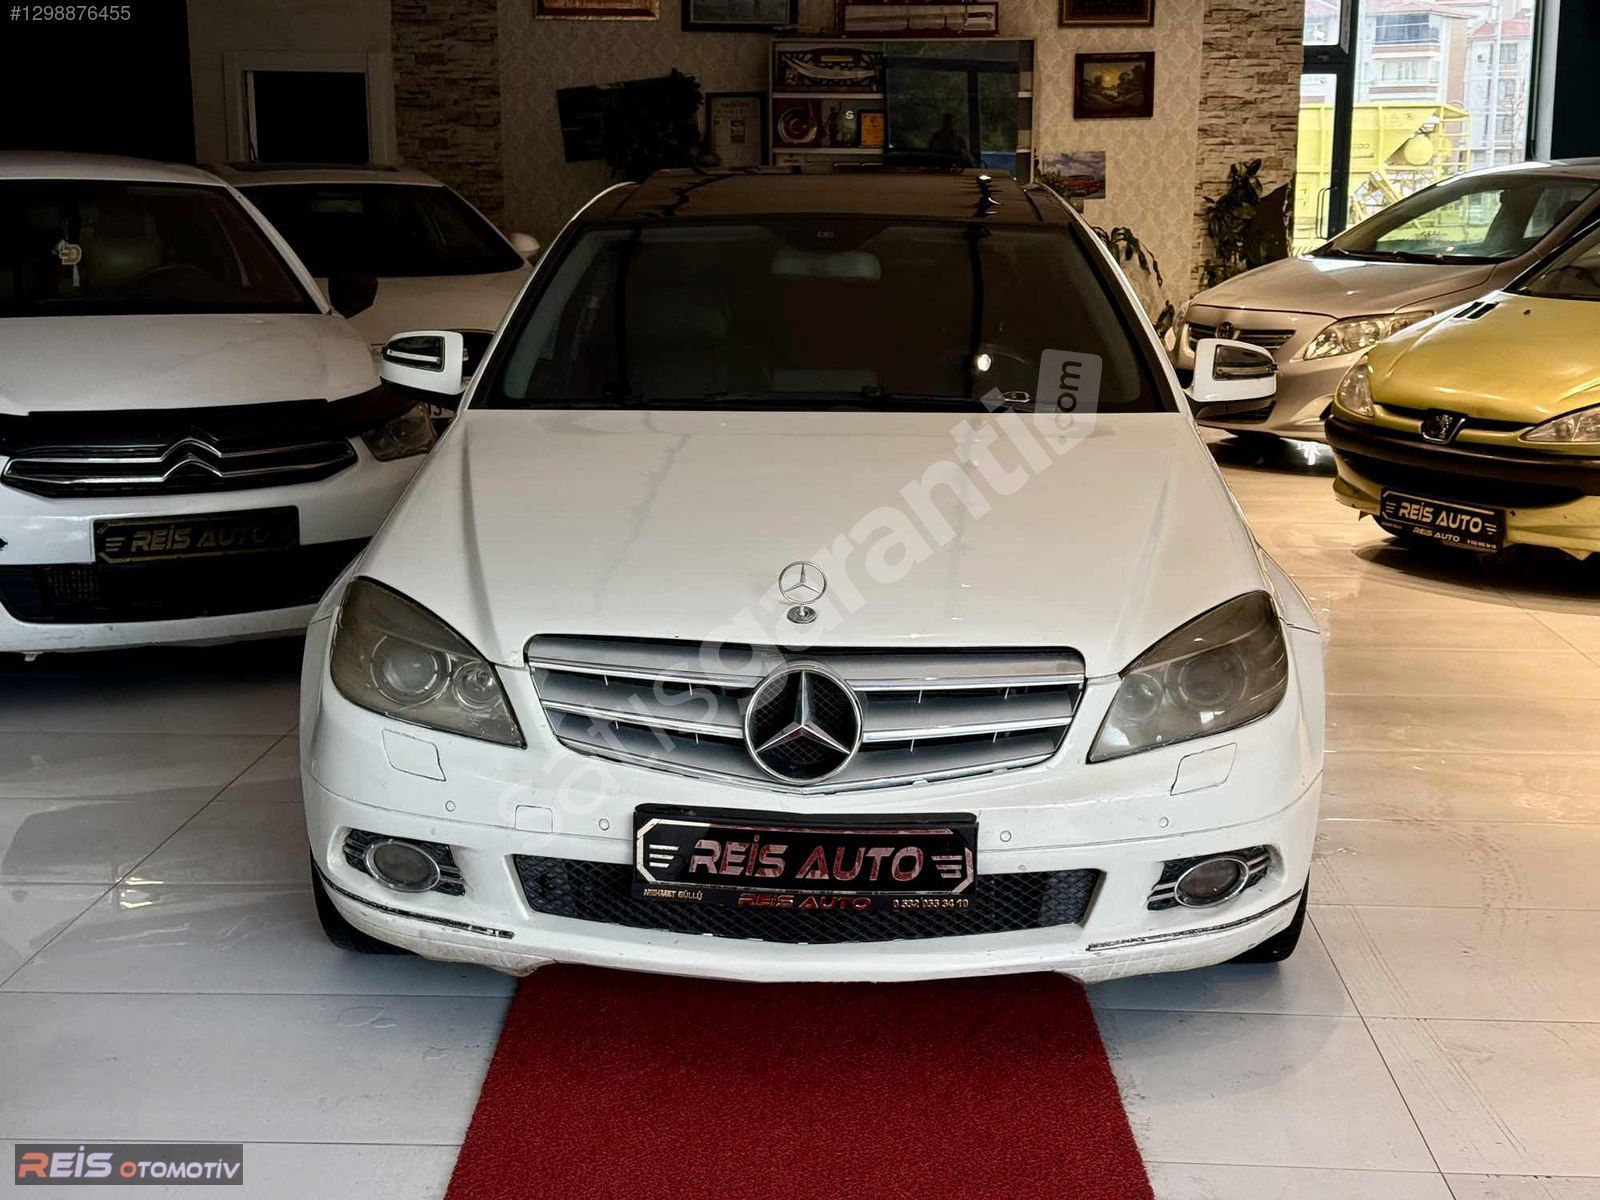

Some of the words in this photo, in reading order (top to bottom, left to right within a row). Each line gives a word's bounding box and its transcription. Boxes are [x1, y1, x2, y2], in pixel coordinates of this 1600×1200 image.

[1436, 510, 1482, 533] AUTO
[196, 526, 269, 548] AUTO
[795, 845, 925, 882] AUTO
[799, 895, 872, 910] AUTO
